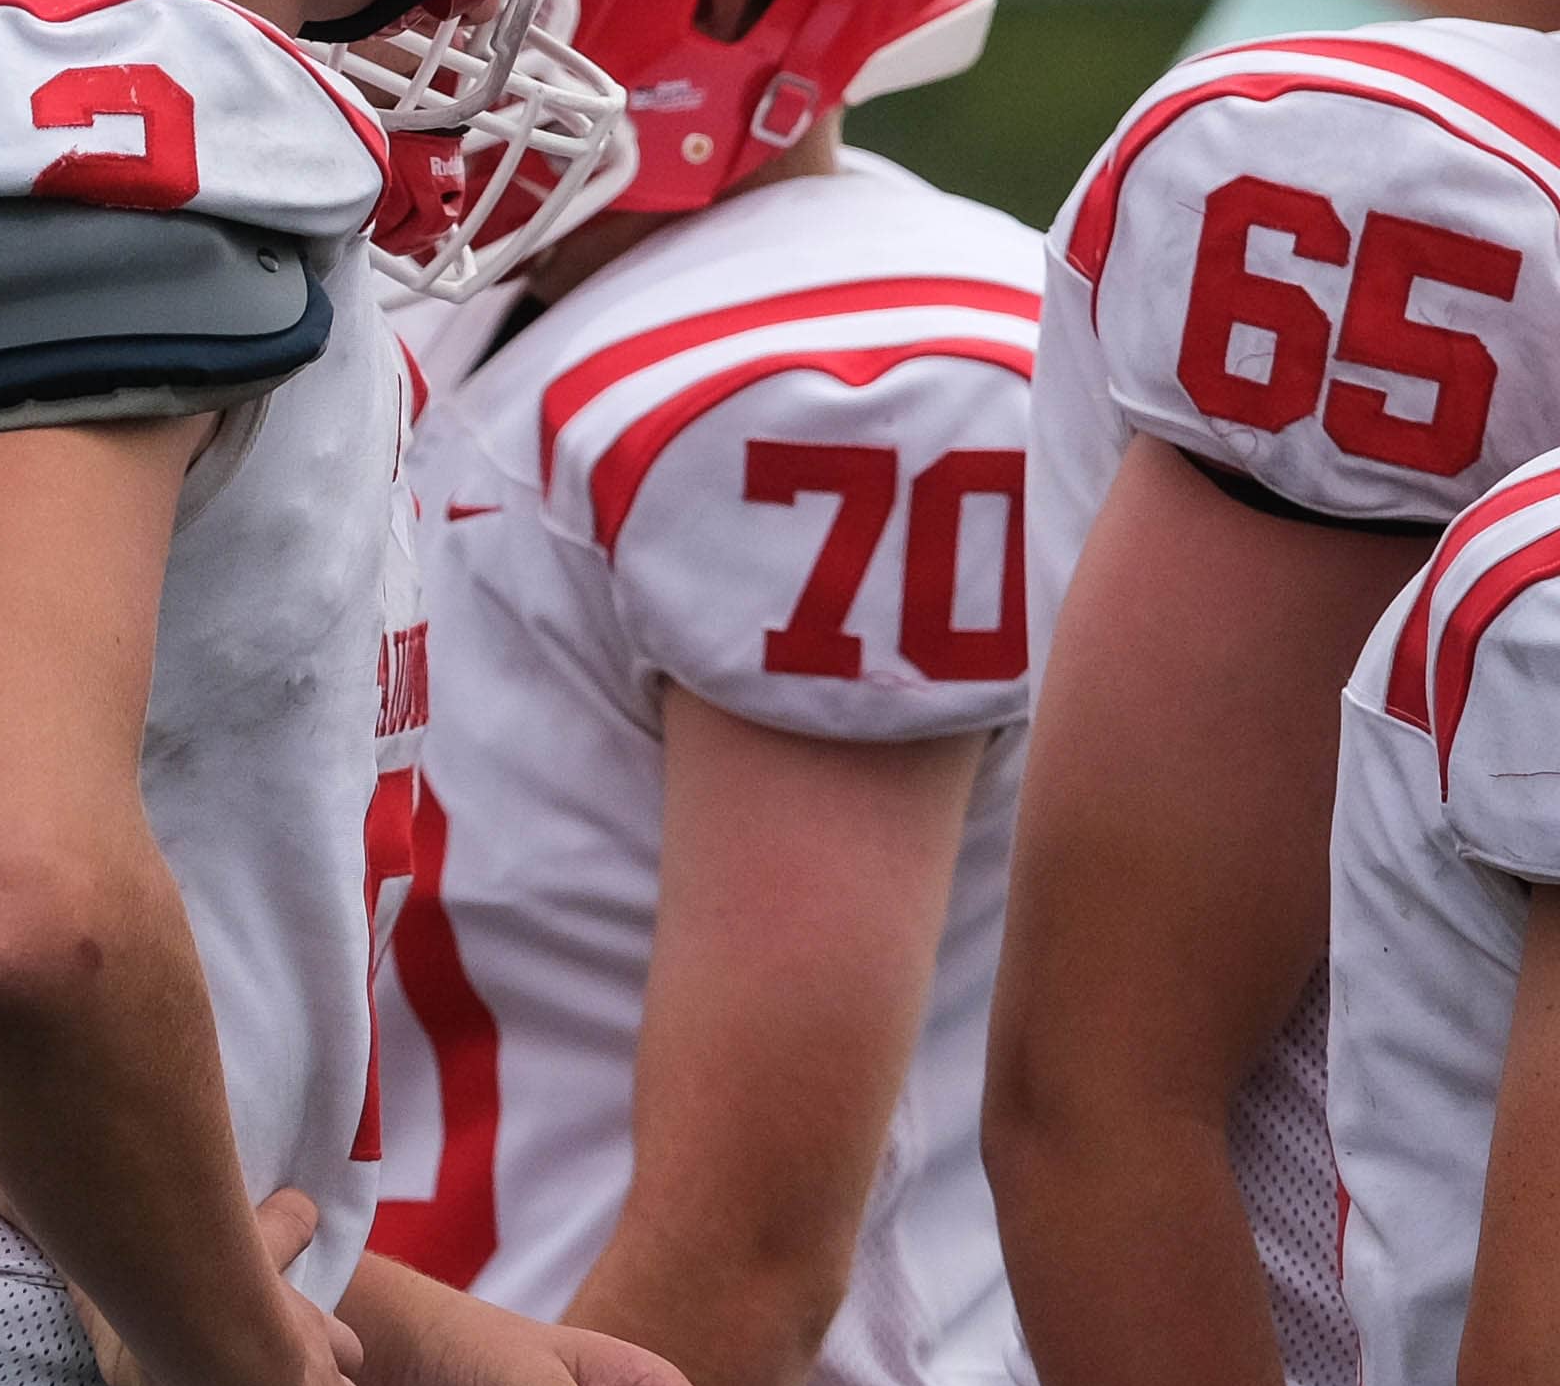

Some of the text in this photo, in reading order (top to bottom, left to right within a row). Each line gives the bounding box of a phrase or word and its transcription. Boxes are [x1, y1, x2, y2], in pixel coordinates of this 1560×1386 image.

[30, 63, 201, 211] 2
[1176, 175, 1522, 478] 65
[743, 440, 1026, 682] 70
